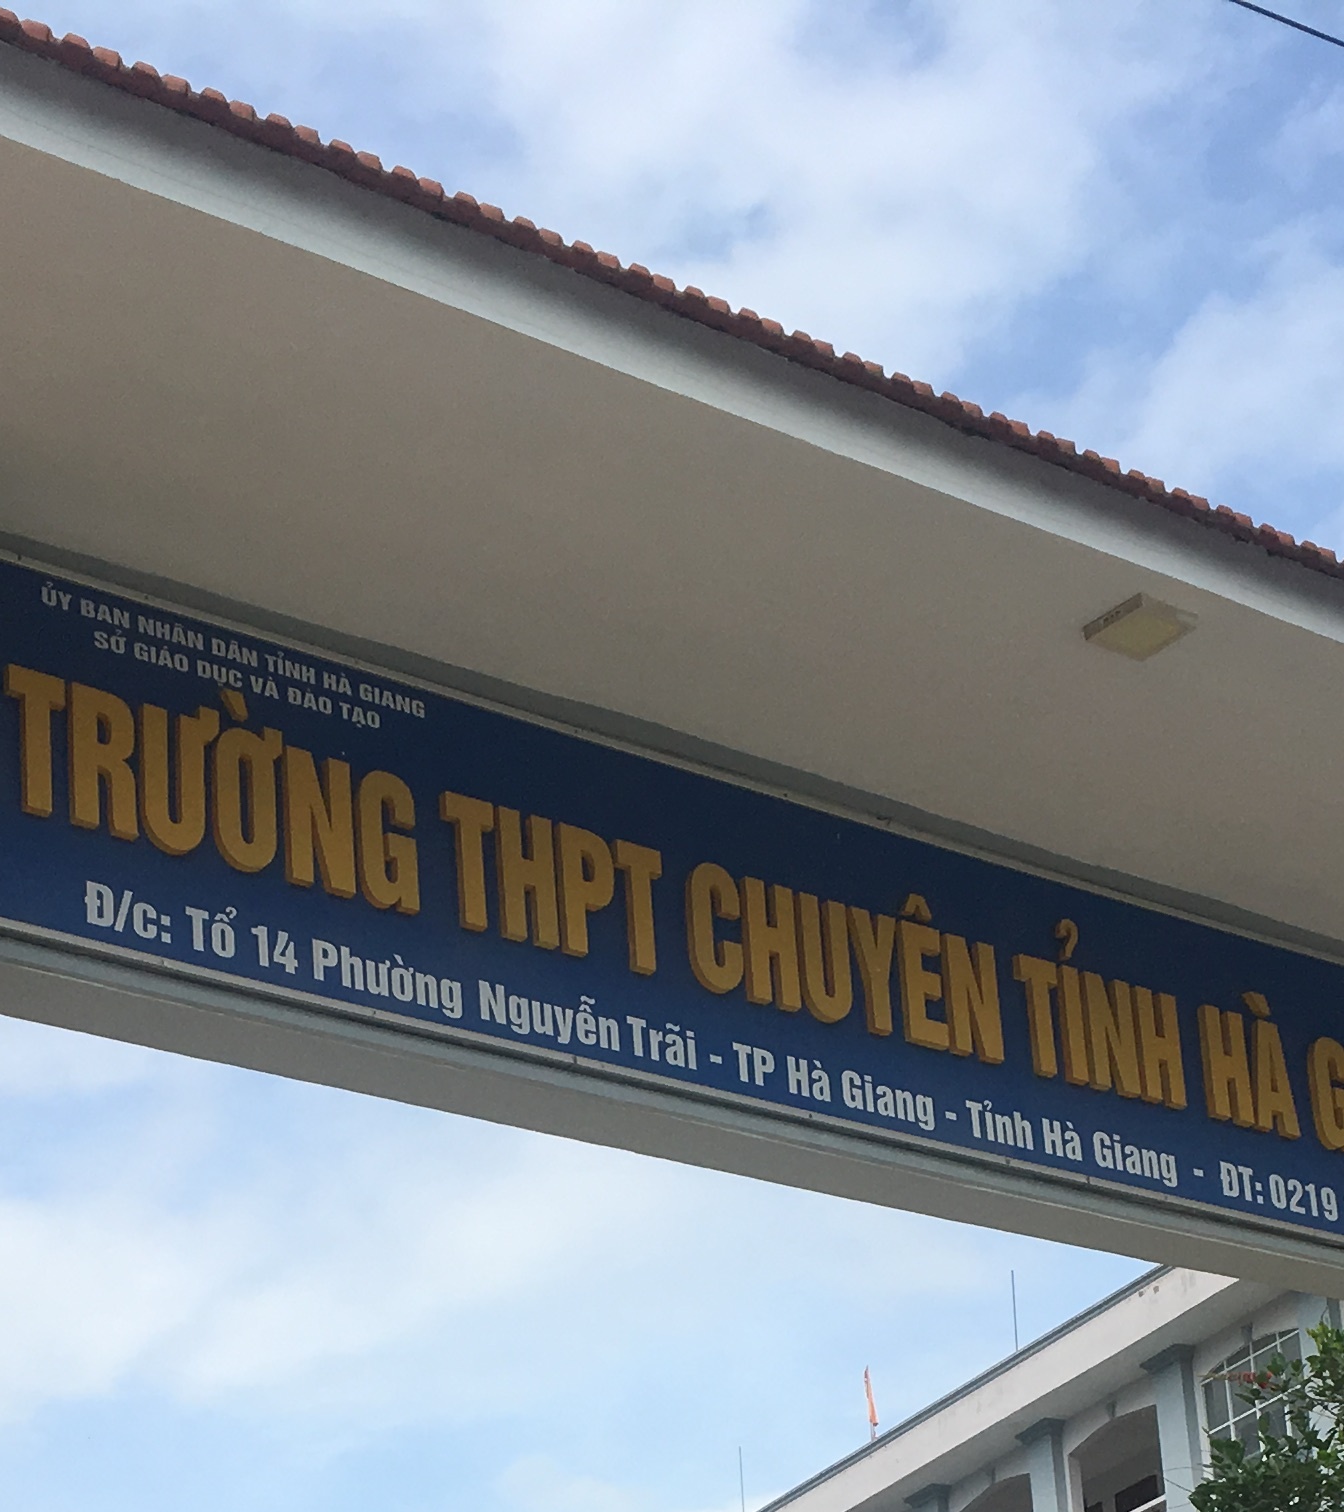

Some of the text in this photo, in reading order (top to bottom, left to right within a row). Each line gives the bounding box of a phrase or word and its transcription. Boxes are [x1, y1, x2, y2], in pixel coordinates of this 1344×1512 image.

[41, 582, 426, 719] ỦY BAN NHÂN DÂN TỈNH HÀ GIANG
[94, 629, 381, 729] SỞ GIÁO DỤC VÀ ĐÀO TẠO
[4, 663, 421, 914] TRƯỜNG
[439, 790, 662, 976] THPT
[684, 861, 1005, 1066] CHUYÊN
[1012, 918, 1188, 1111] TỈNH
[1197, 991, 1301, 1140] HÀ
[84, 880, 172, 944] Đ/c:
[184, 905, 235, 958] Tổ
[250, 925, 298, 974] 14
[312, 938, 463, 1019] Phường
[478, 979, 621, 1052] Nguyễn
[625, 1015, 698, 1071] Trãi
[732, 1041, 775, 1087] TP
[786, 1055, 831, 1102] Hà
[841, 1069, 935, 1131] Giang
[965, 1099, 1034, 1150] Tỉnh
[1042, 1117, 1082, 1162] Hà
[1093, 1131, 1178, 1188] Giang
[1219, 1160, 1264, 1205] ĐT:
[1269, 1173, 1339, 1222] 0219
